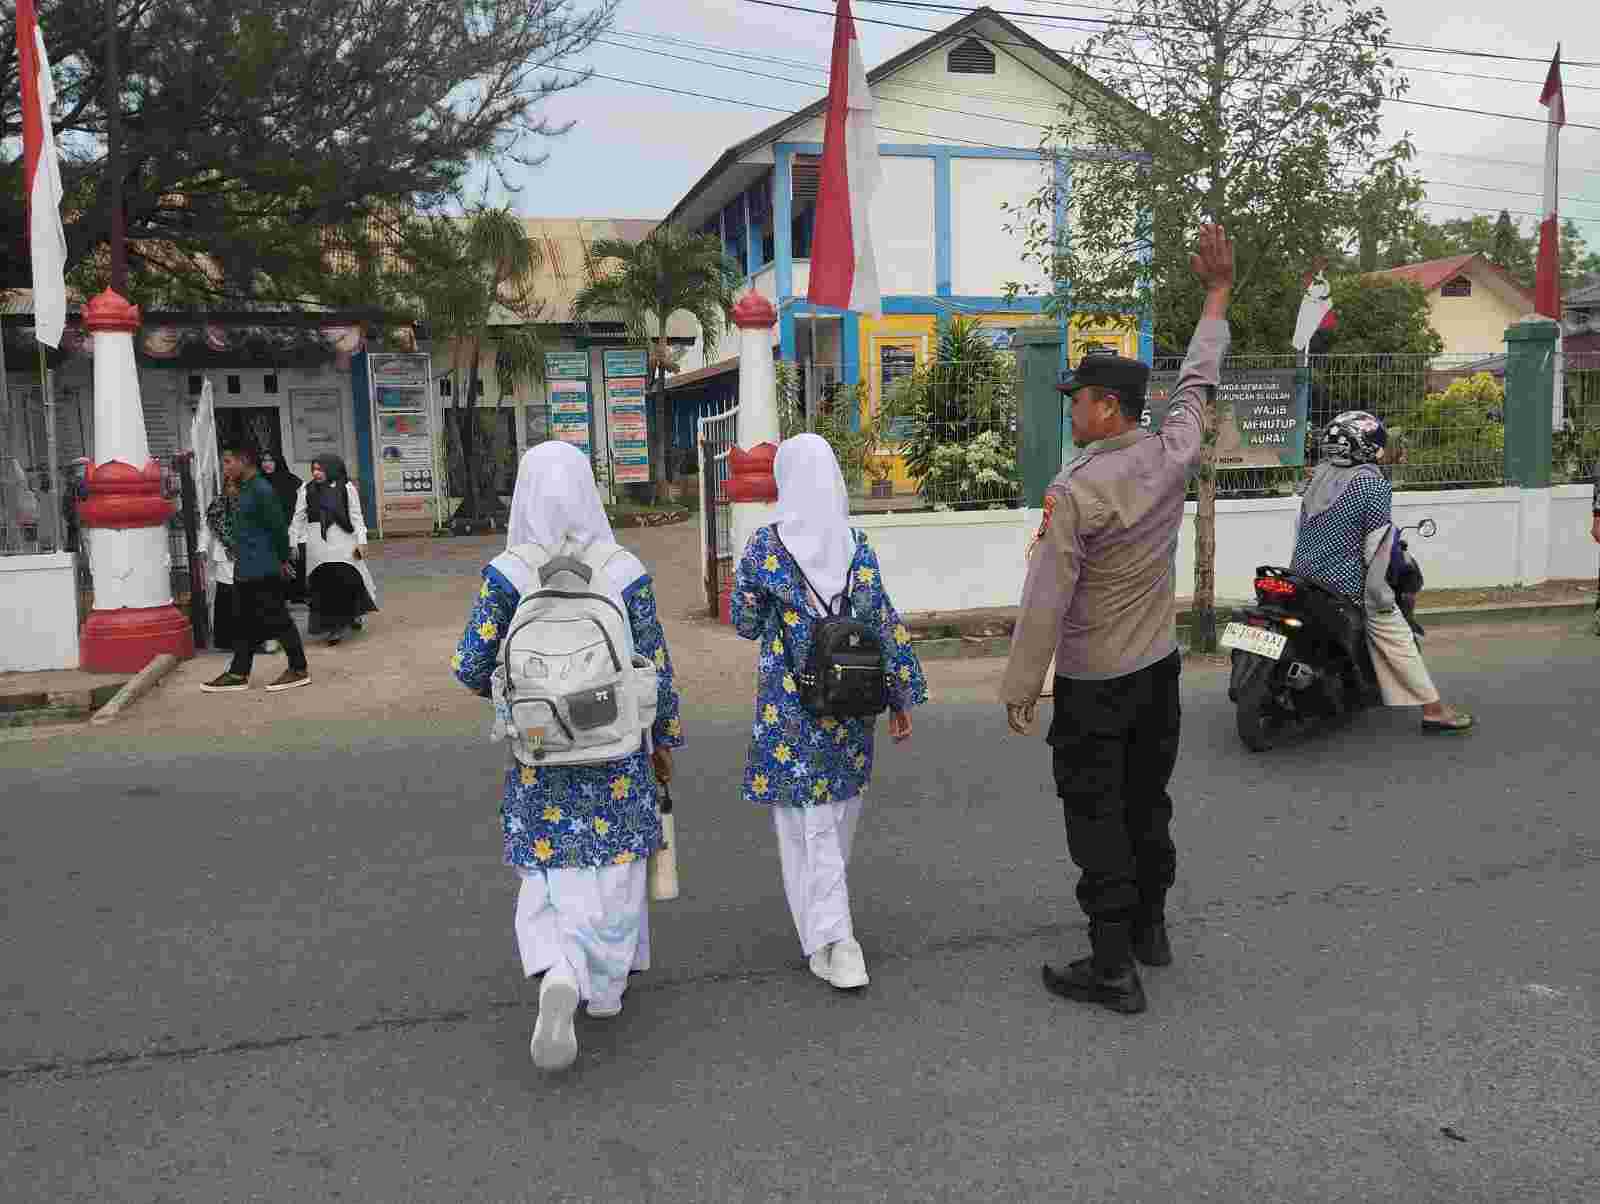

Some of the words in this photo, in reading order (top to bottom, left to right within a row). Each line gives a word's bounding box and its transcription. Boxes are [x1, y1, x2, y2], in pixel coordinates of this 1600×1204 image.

[1253, 404, 1287, 415] WAJIB
[1242, 418, 1297, 431] MENUTUP
[1249, 432, 1287, 444] AURAT
